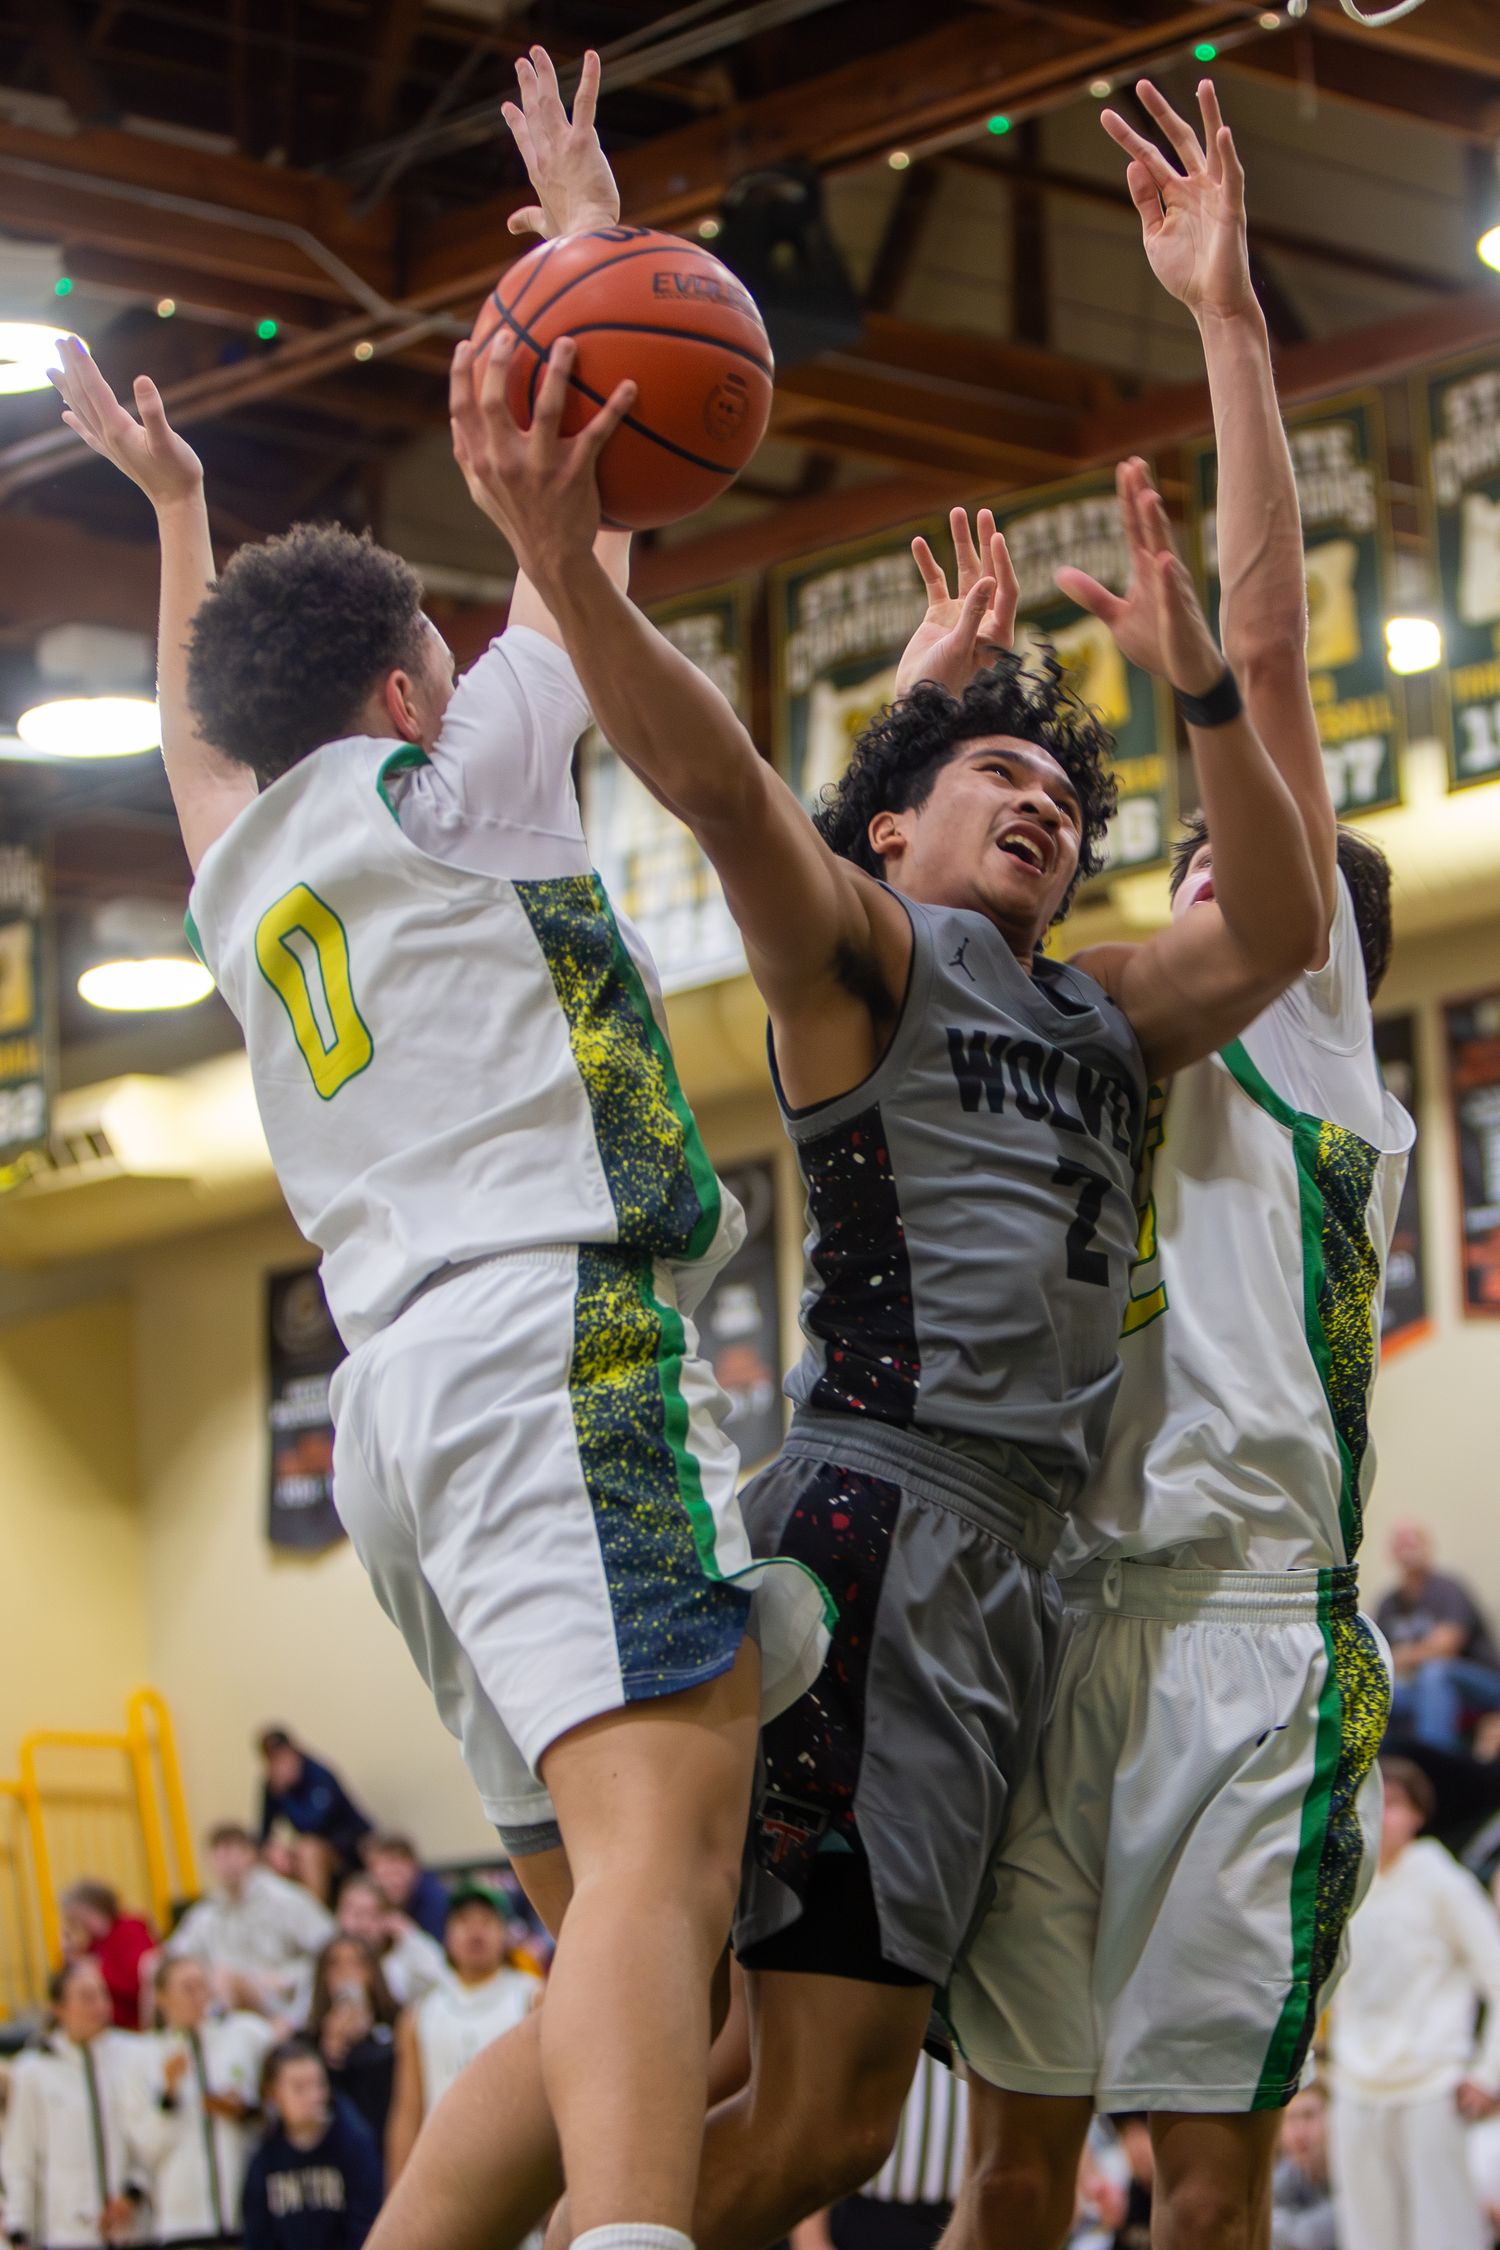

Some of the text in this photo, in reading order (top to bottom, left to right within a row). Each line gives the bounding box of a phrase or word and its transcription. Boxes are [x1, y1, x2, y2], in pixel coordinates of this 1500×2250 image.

[255, 882, 374, 1100] 0
[946, 1028, 1135, 1153] WOLVE
[1051, 1155, 1111, 1287] 2
